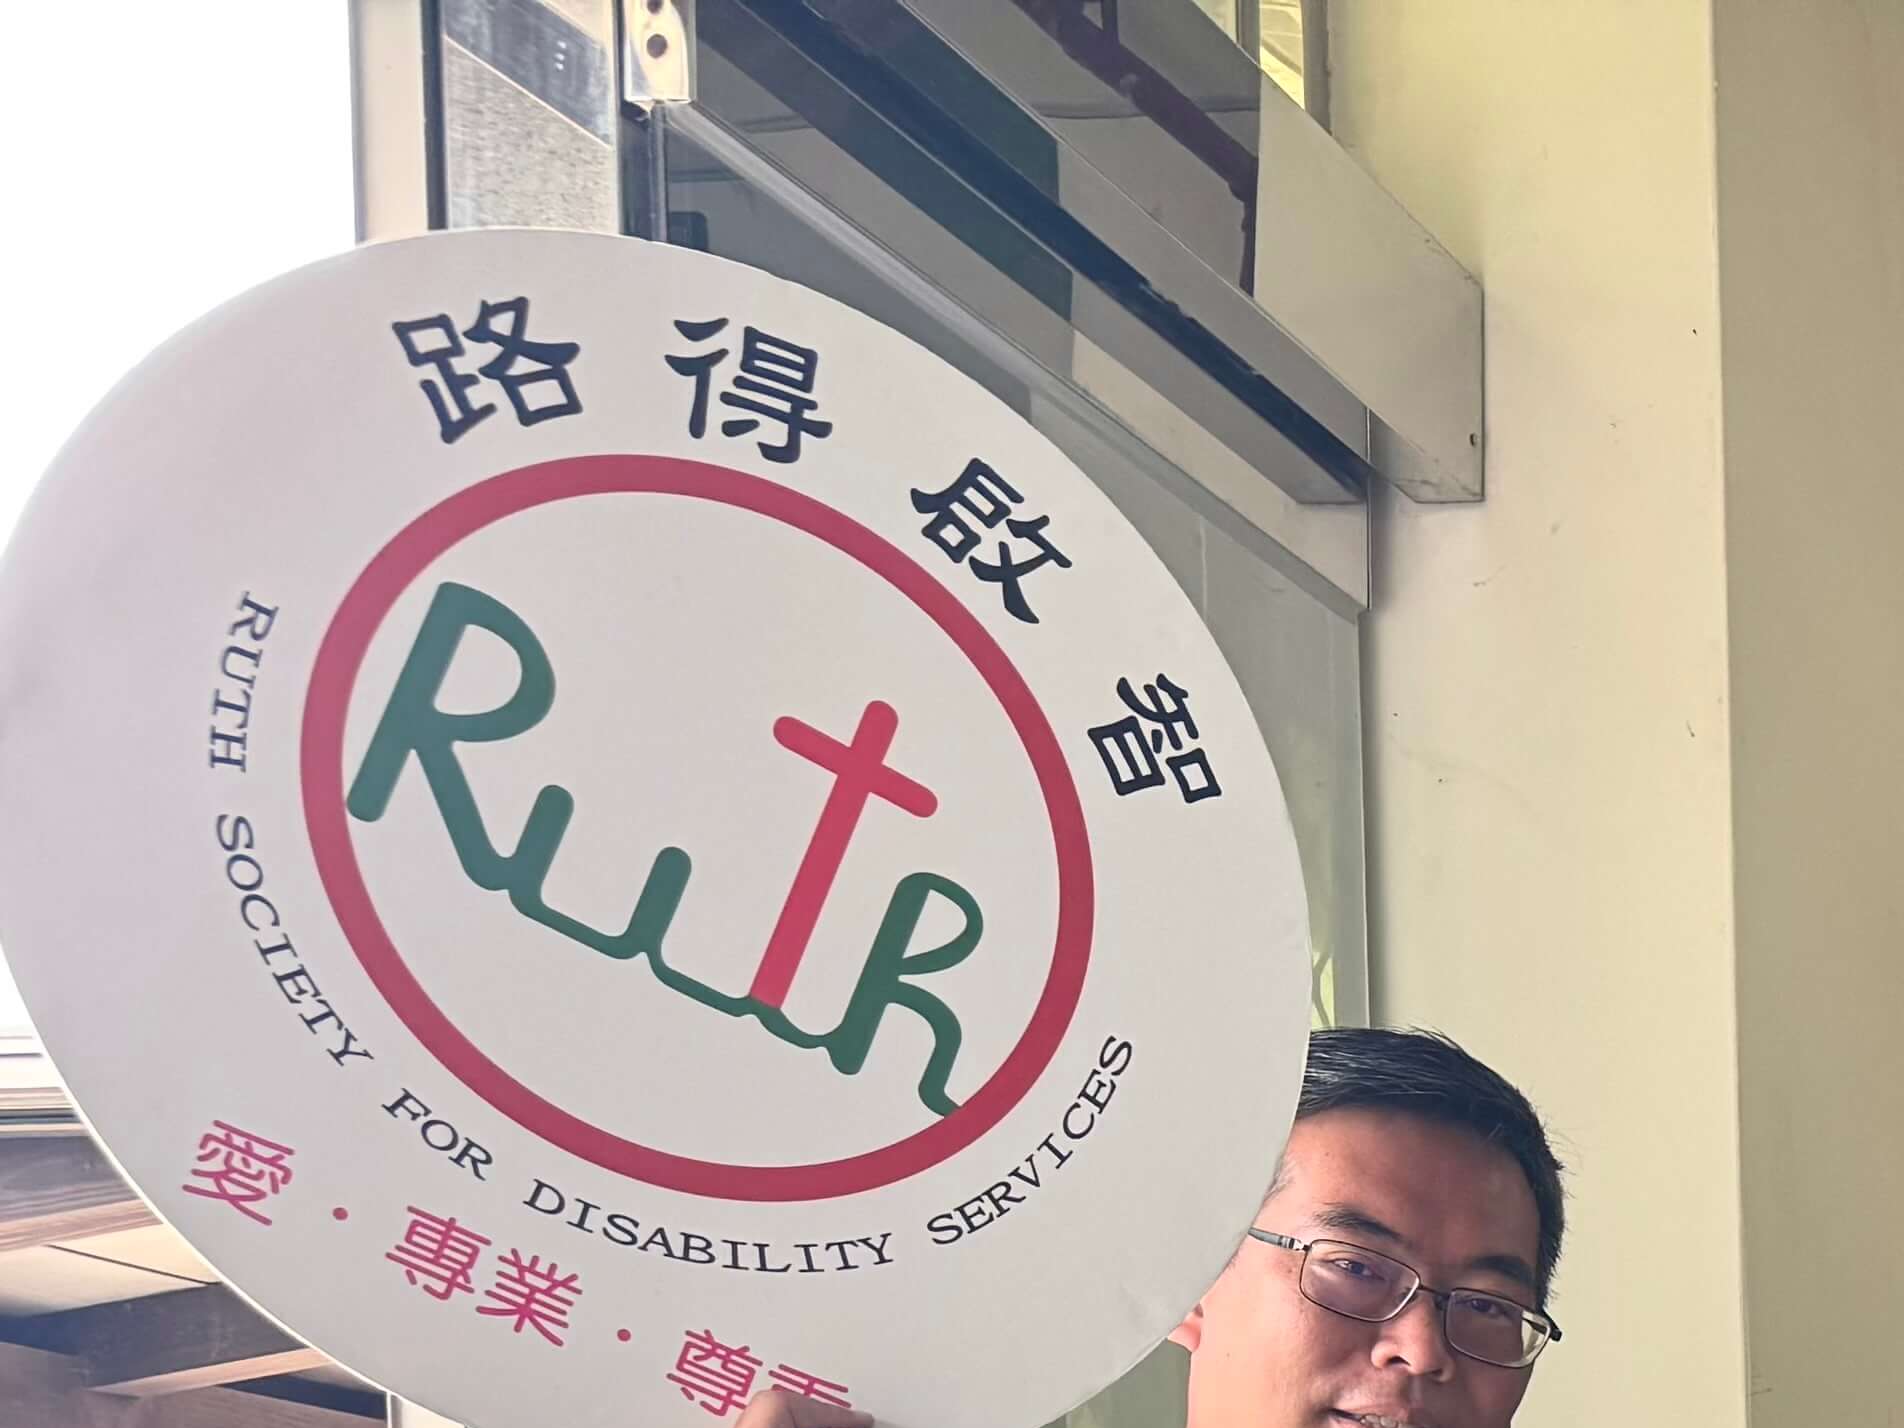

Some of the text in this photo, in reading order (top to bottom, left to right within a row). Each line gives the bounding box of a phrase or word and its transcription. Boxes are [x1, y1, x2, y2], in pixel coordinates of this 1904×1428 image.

[208, 590, 1136, 1273] RUTH SOCIETY FOR DISABILITY SERVICES
